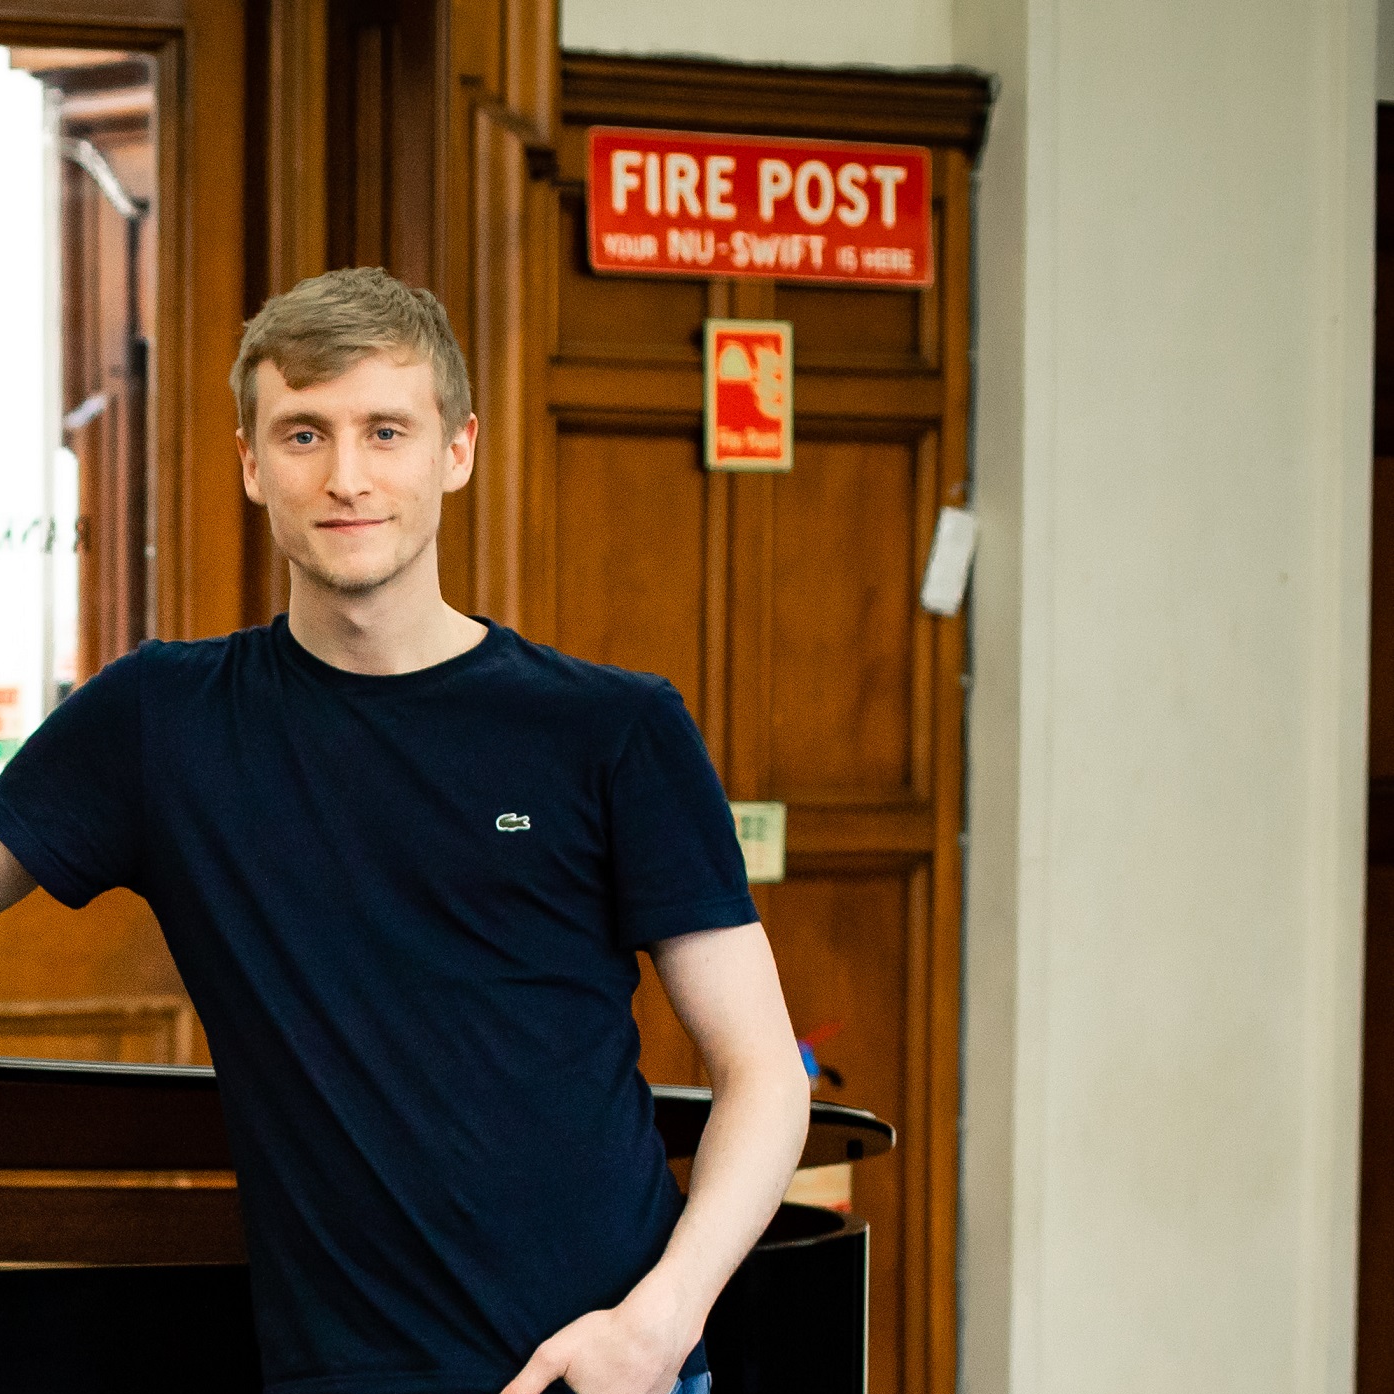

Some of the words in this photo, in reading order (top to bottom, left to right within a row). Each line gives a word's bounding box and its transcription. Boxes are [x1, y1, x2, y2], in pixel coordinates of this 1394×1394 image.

[610, 150, 738, 220] FIRE
[757, 157, 907, 229] POST
[665, 228, 827, 269] NU-SWIFT
